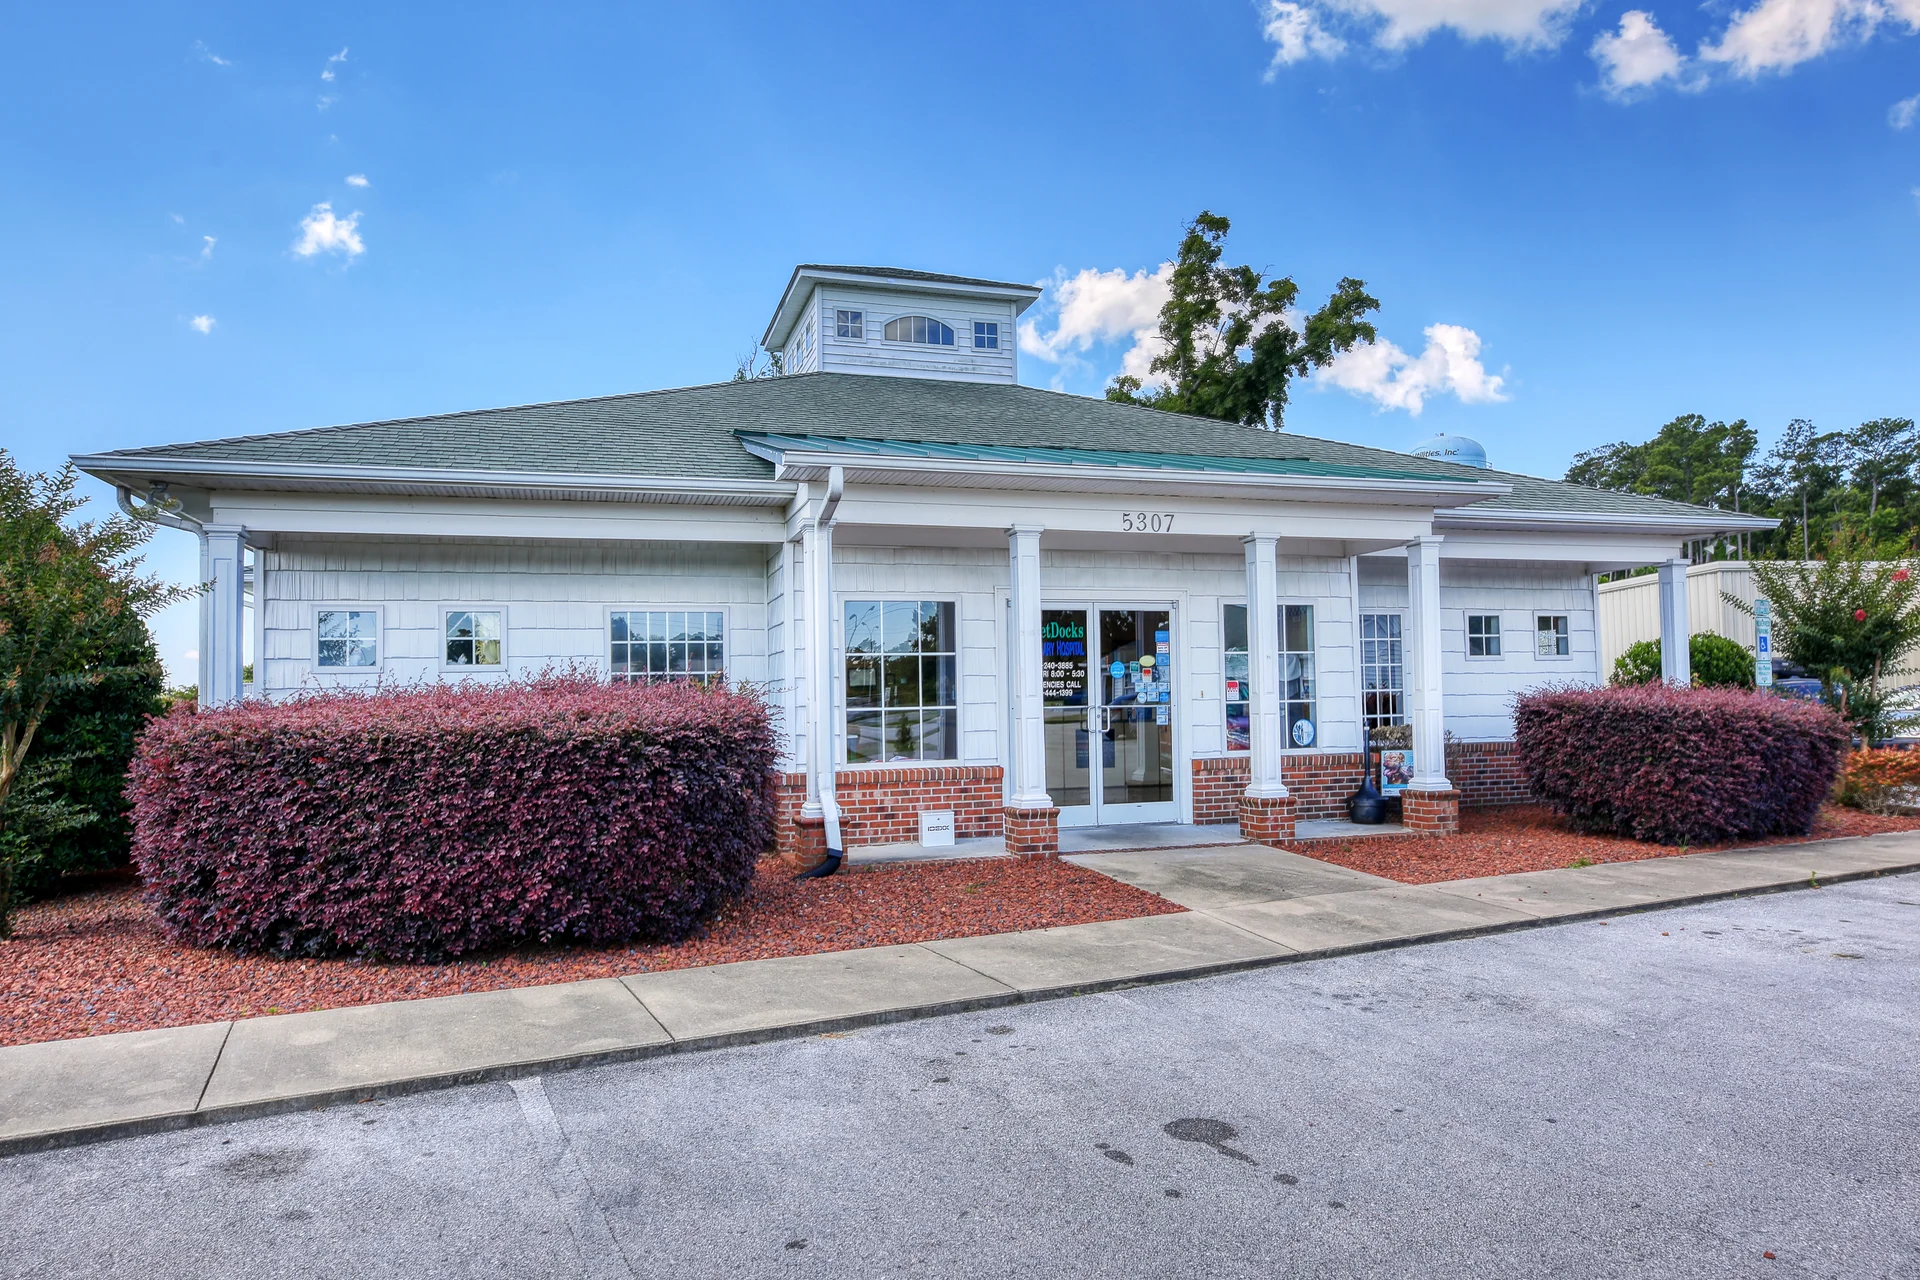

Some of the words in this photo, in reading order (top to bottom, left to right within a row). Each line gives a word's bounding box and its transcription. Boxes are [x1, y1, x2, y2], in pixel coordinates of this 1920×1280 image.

[1122, 512, 1175, 533] 5307
[1042, 621, 1084, 639] etDocks
[1071, 669, 1085, 677] 5:30
[1042, 680, 1065, 688] ENCIES
[1066, 680, 1081, 688] CALL
